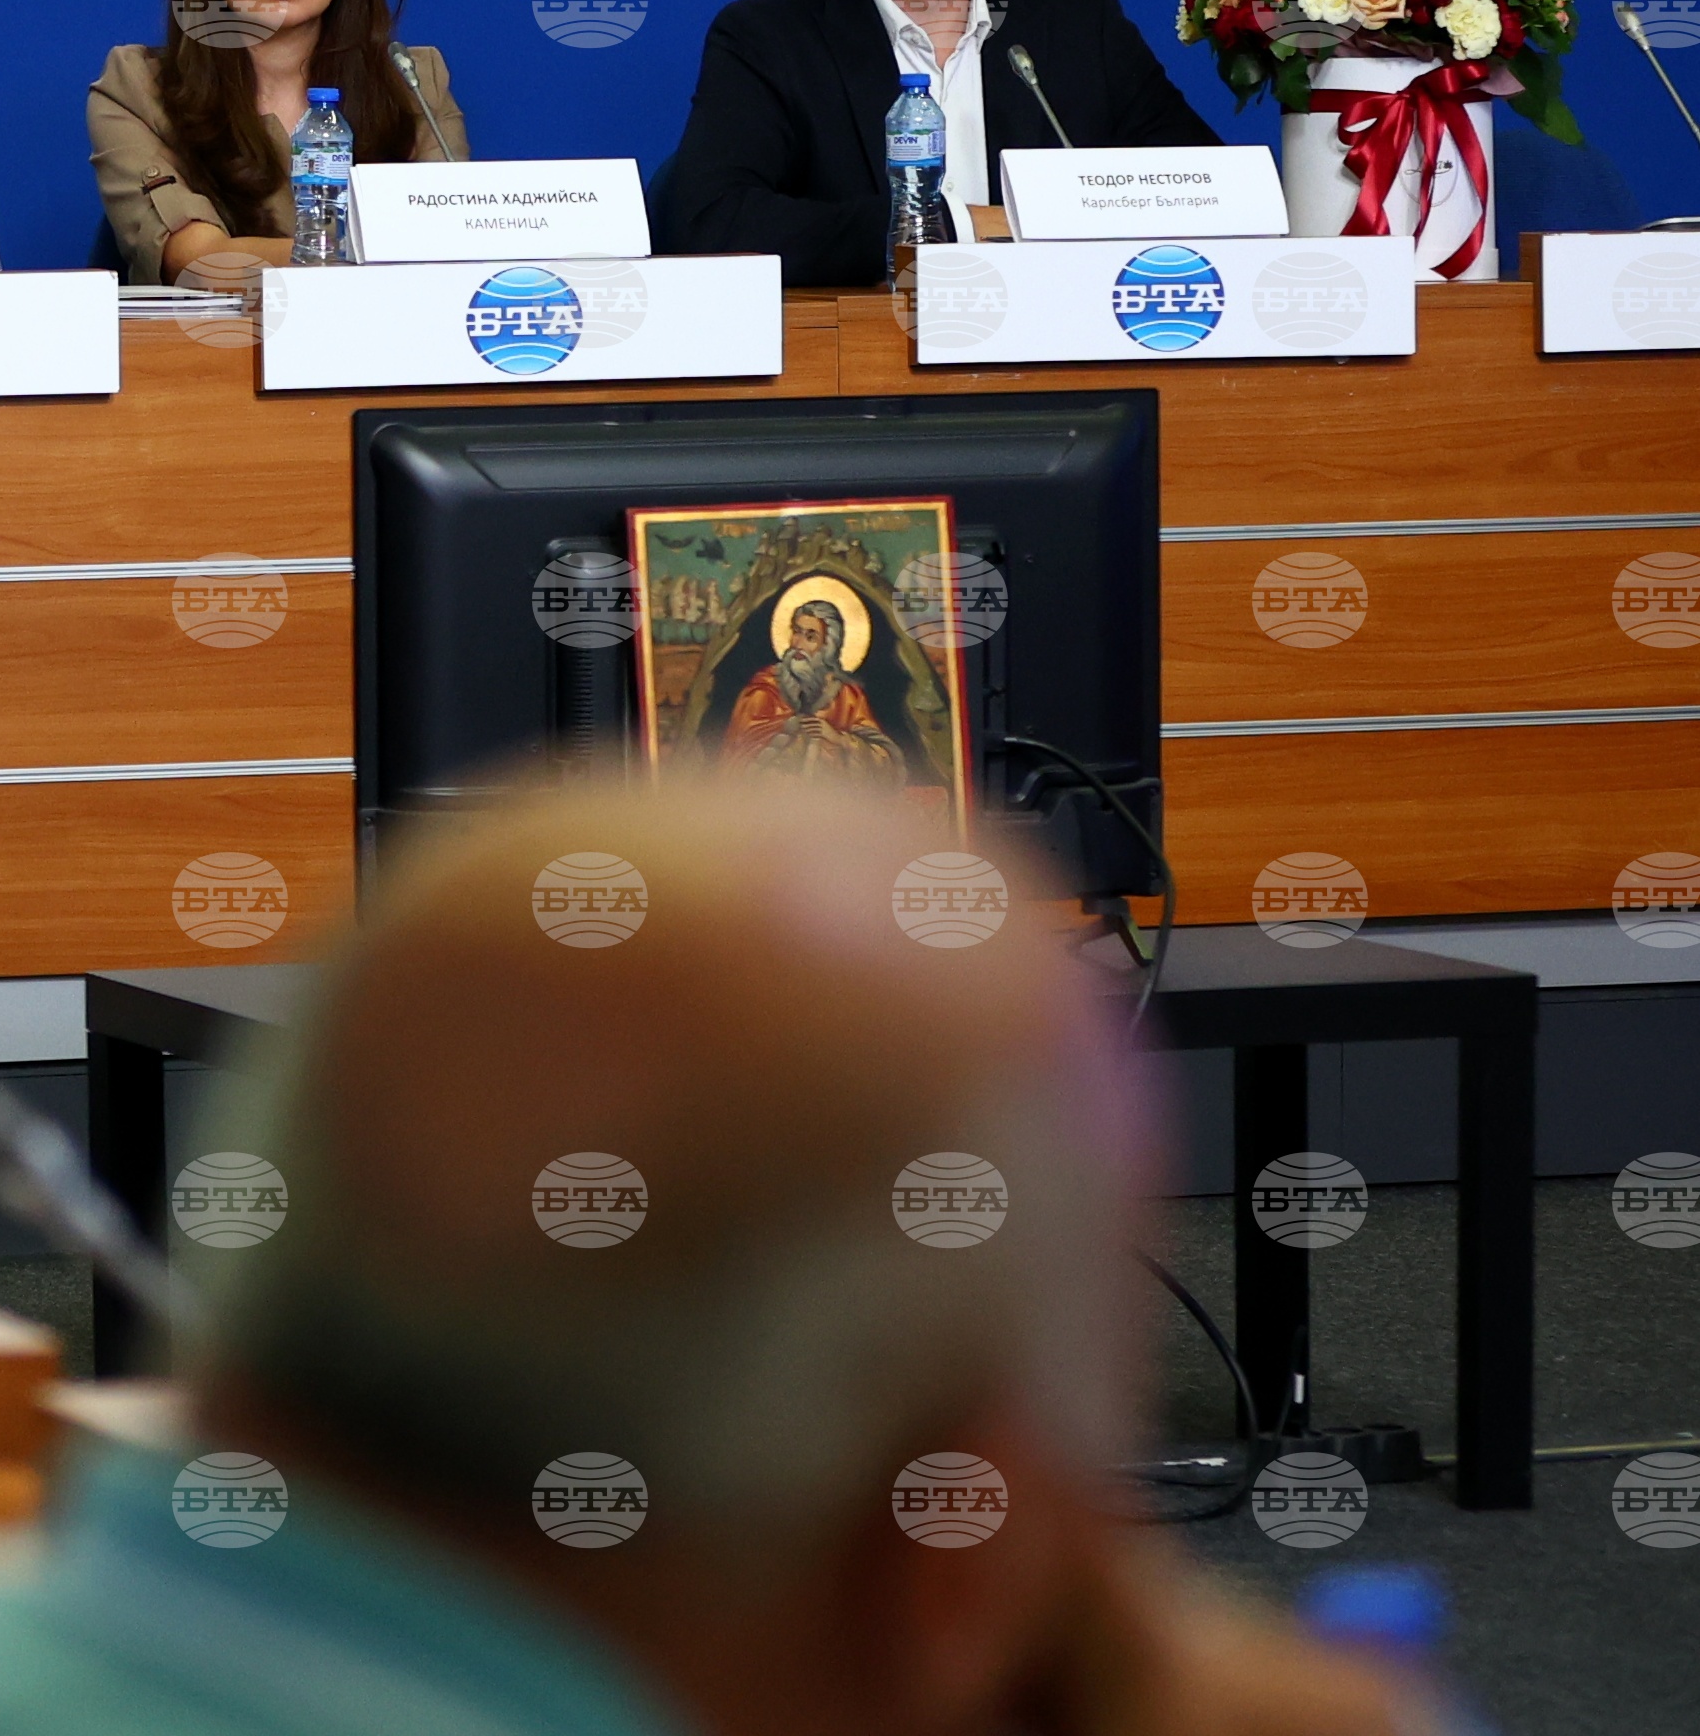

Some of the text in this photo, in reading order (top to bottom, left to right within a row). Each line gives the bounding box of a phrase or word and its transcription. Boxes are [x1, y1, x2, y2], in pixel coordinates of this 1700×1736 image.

[893, 136, 919, 145] DEVIN
[1077, 172, 1212, 189] ТЕОДОР НЕСТОРОВ
[407, 189, 599, 207] РАДОСТИНА ХАДЖИЙСКА
[1081, 193, 1219, 210] Карлсберг България
[464, 217, 549, 232] КАМЕНИЦА
[1114, 282, 1225, 314] БТА
[467, 305, 583, 337] БТА
